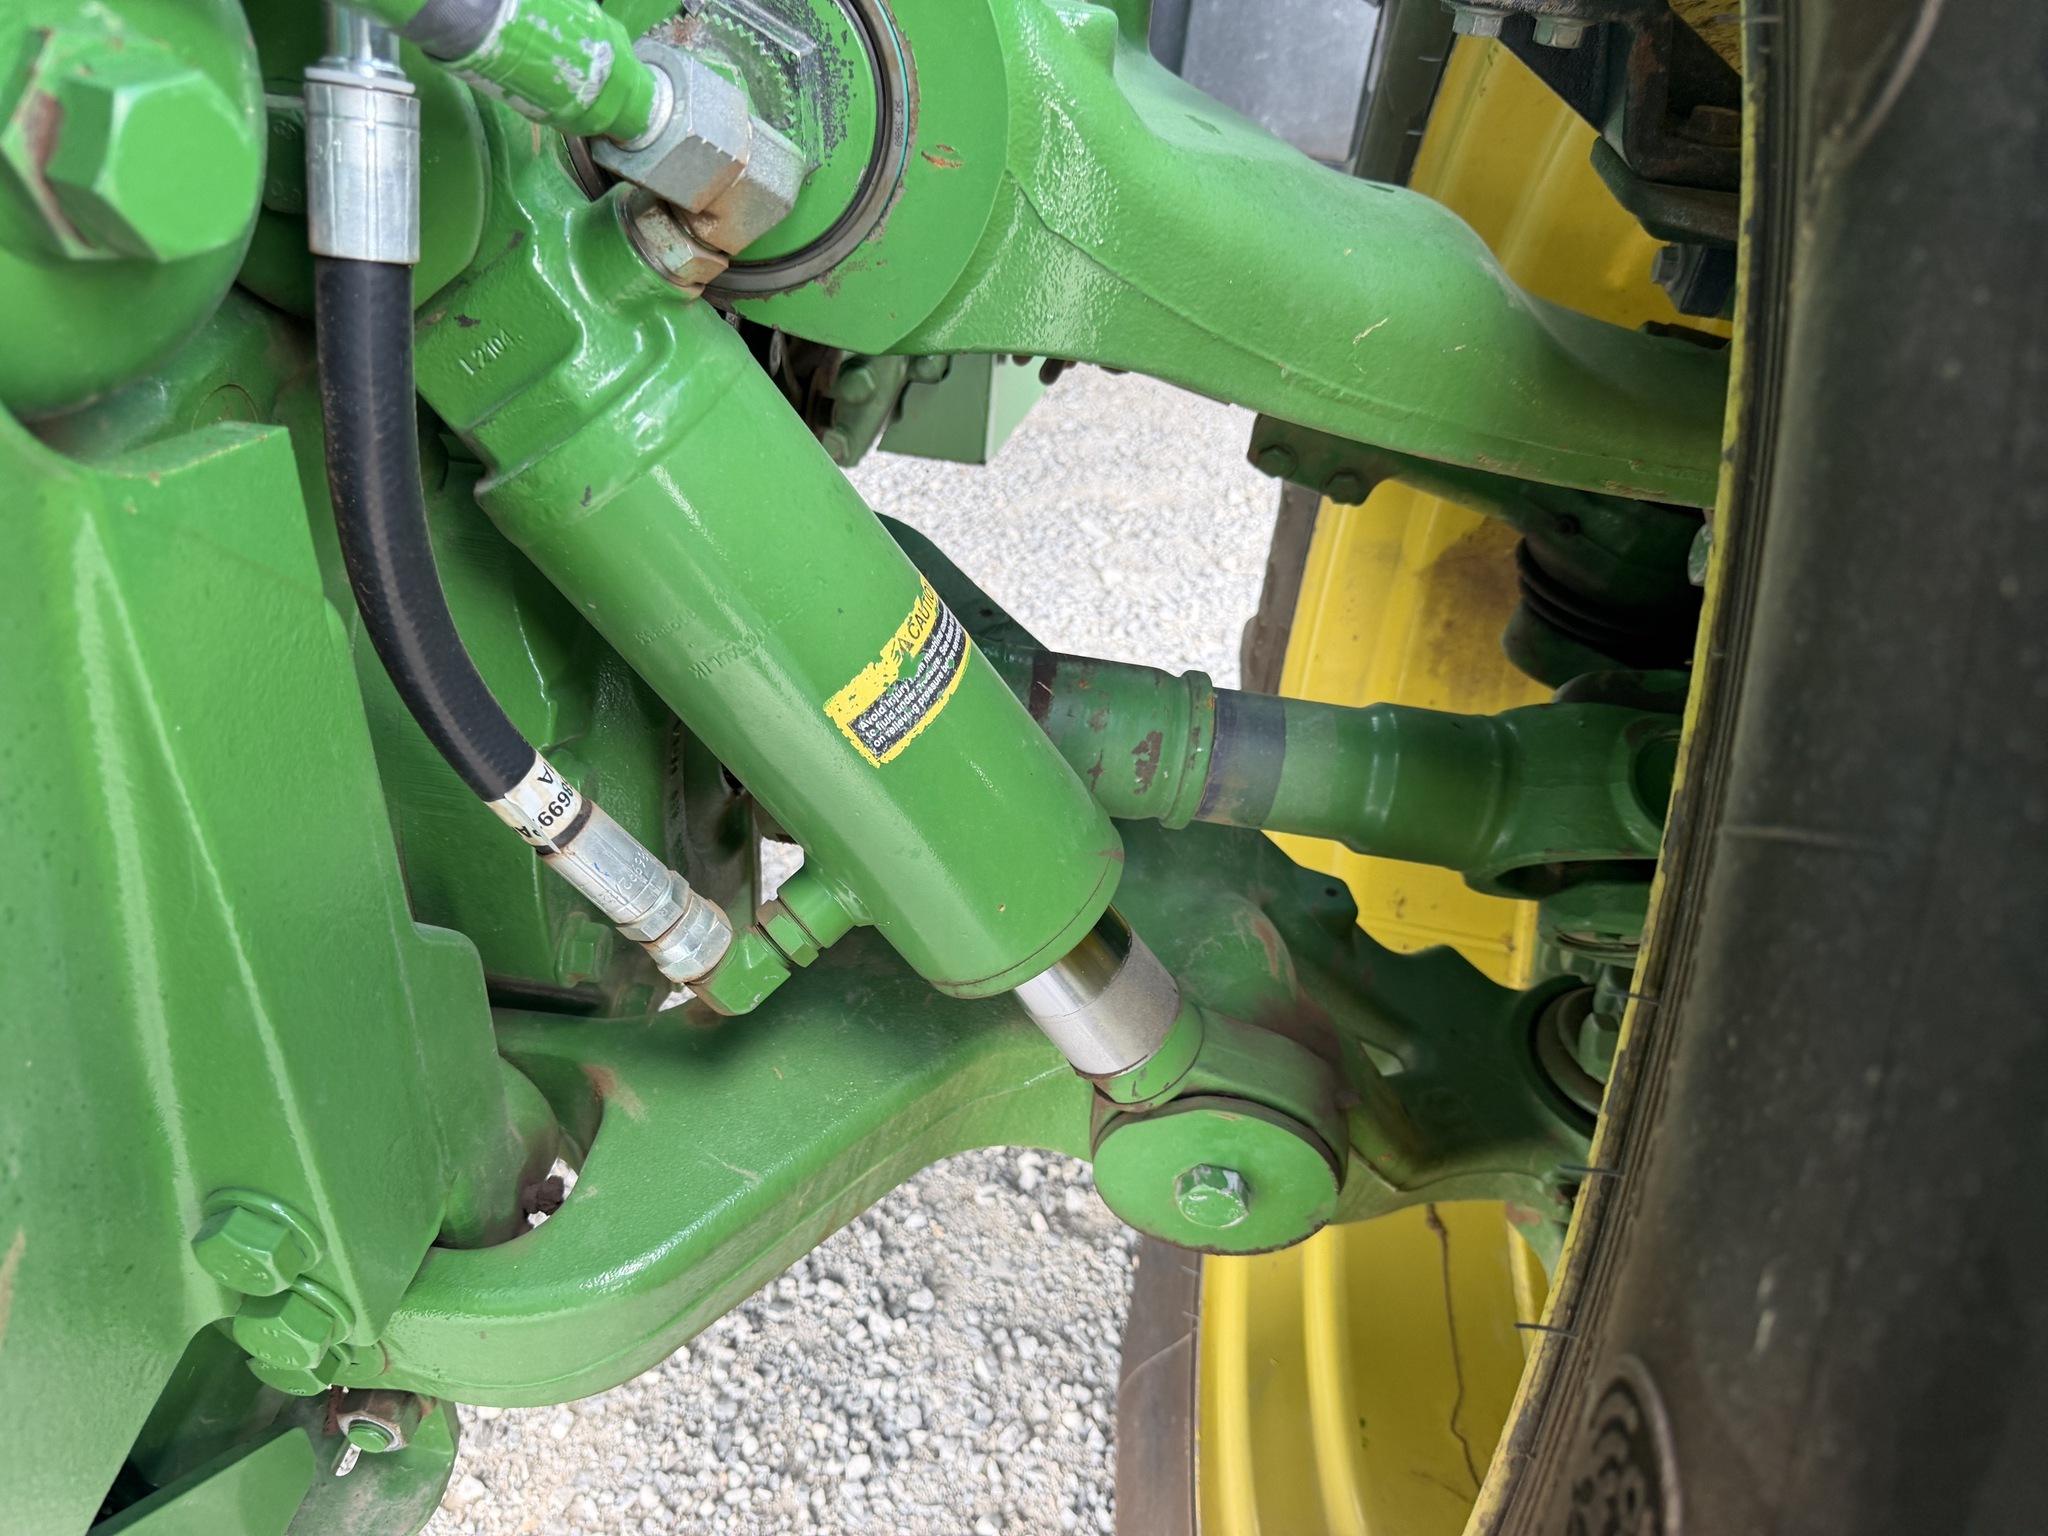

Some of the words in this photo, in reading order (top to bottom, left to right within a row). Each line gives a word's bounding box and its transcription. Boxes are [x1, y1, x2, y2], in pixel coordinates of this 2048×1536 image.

[873, 736, 886, 748] on
[918, 671, 944, 707] pressure
[895, 689, 917, 713] under
[859, 704, 887, 731] Avoid
